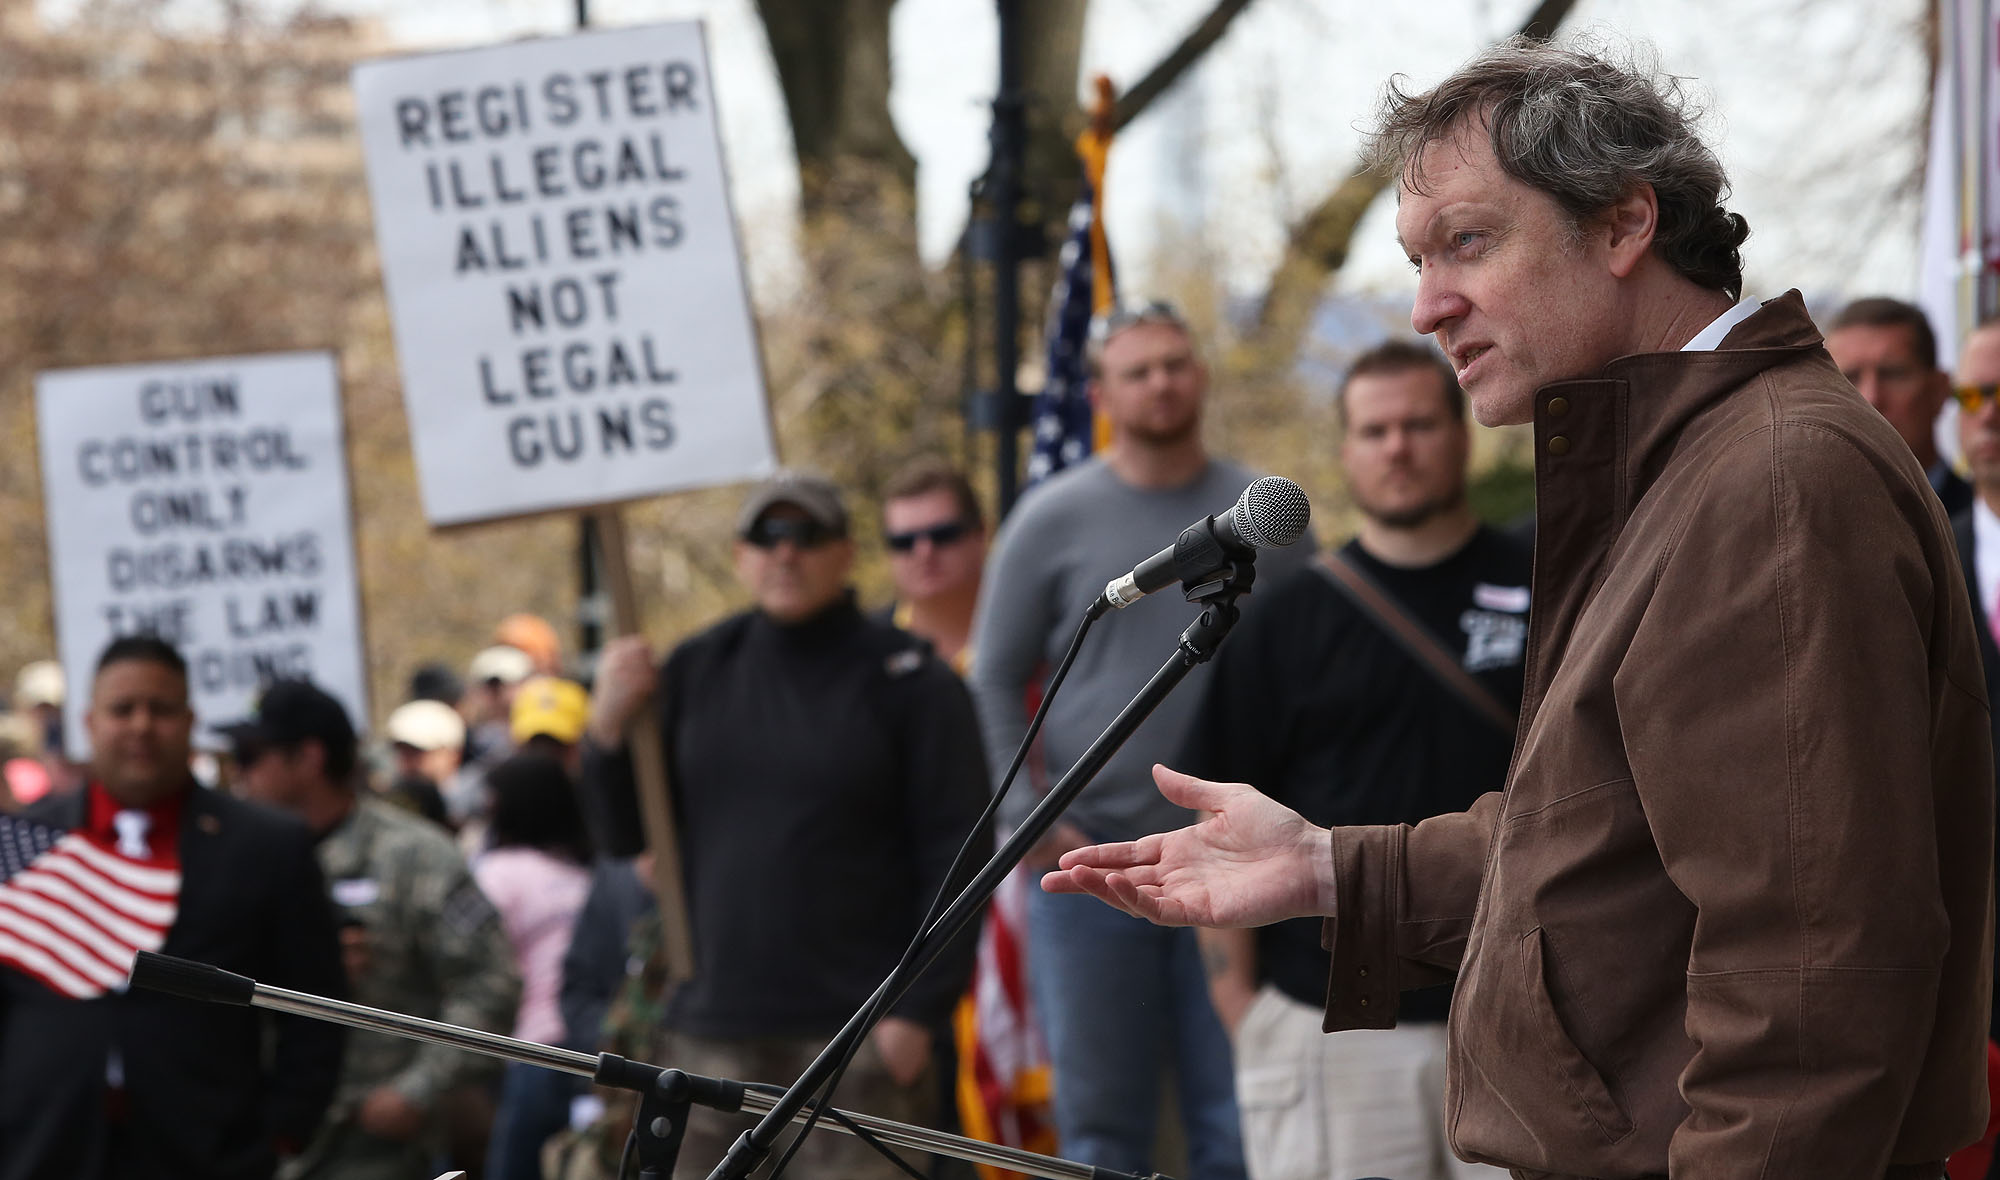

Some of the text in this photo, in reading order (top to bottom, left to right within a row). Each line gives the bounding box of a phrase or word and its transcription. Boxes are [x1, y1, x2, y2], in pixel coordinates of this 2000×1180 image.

[396, 62, 699, 149] REGISTER
[426, 134, 689, 210] ILLEGAL
[455, 196, 685, 275] ALIENS
[507, 272, 620, 334] NOT
[139, 380, 240, 425] GUN
[479, 336, 678, 407] LEGAL
[77, 428, 308, 487] CONTROL
[508, 400, 677, 468] GUNS
[131, 487, 247, 535] ONLY
[106, 530, 323, 592] DISARMS
[102, 592, 320, 645] THE LAW
